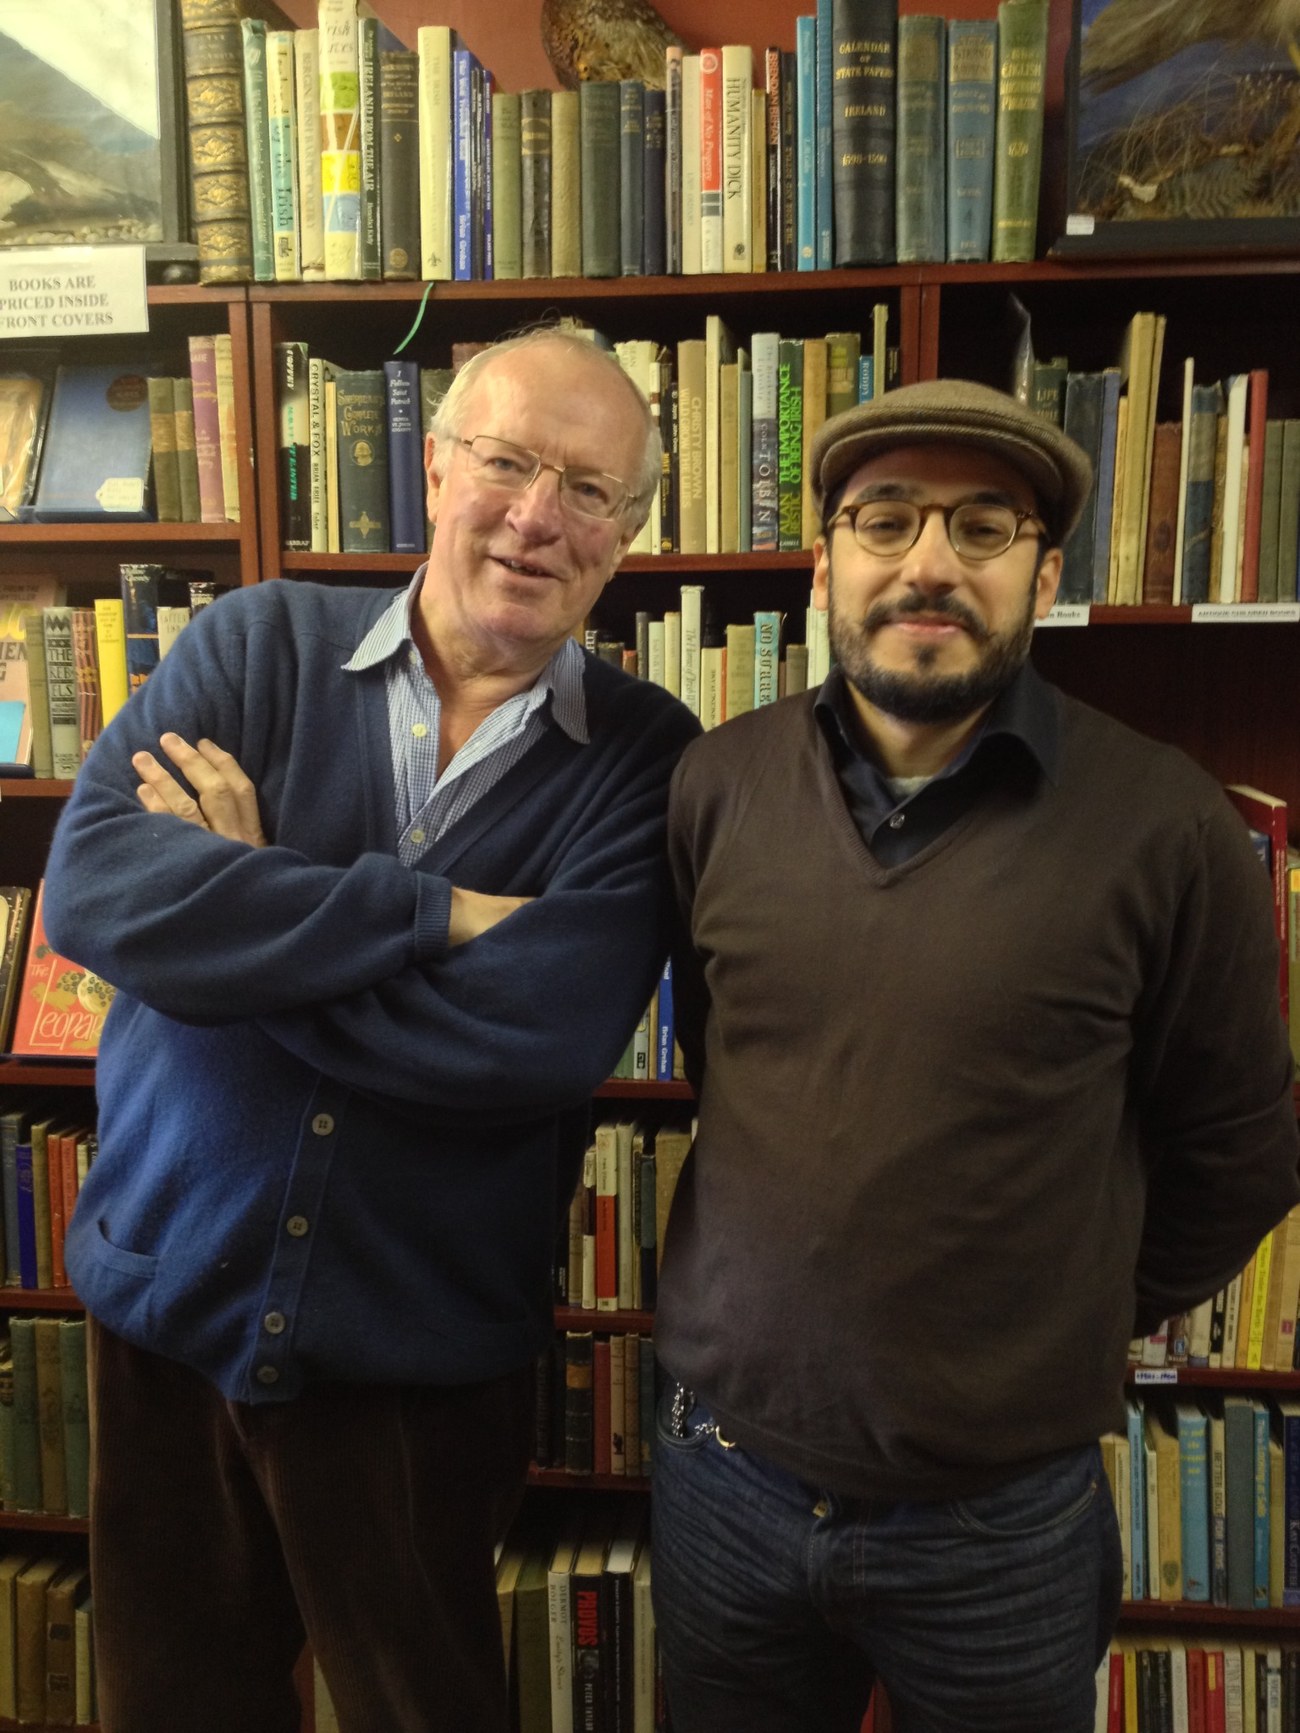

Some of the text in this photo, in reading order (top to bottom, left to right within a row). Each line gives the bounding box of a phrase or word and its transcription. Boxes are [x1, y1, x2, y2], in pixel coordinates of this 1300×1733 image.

[839, 41, 890, 54] CALENDAR
[302, 53, 312, 98] BERGIN
[364, 61, 375, 114] IRELAND
[768, 53, 779, 105] BRENDAN
[836, 66, 862, 80] STATE
[303, 101, 313, 134] IRISH
[769, 106, 780, 145] BEHAN
[844, 103, 886, 117] IRELAND
[365, 116, 375, 149] FROM
[726, 78, 743, 200] HUMANITY DICK
[366, 151, 375, 170] THE
[702, 141, 713, 182] Property
[367, 171, 375, 191] AIR
[278, 187, 294, 228] Irish
[306, 183, 316, 229] POETRY
[0, 293, 109, 310] PRICED INSIDE
[9, 274, 96, 292] BOOKS ARE
[52, 312, 113, 328] COVERS
[861, 362, 869, 396] RODDY
[311, 363, 321, 457] CRYSTAL & FOX
[341, 420, 383, 437] WORKS
[779, 363, 791, 484] THE IMPORTANCE
[680, 388, 692, 509] WILD GROW THE LILIES
[691, 396, 702, 499] CHRISTY BROWN
[760, 423, 769, 450] COLM
[790, 387, 802, 484] OF BEING IRISH
[312, 463, 320, 484] BRIAN
[779, 493, 790, 535] ALAN
[790, 493, 802, 534] BESTIC
[48, 649, 73, 661] THE
[759, 623, 774, 705] NO SURRE
[30, 963, 49, 977] The
[29, 958, 107, 1050] Leopar
[1213, 1451, 1223, 1488] BETTER
[550, 1584, 558, 1624] BOLGER
[559, 1585, 568, 1624] DERMOT
[577, 1591, 598, 1646] PROVOS
[584, 1683, 594, 1731] PETER TAYLOR
